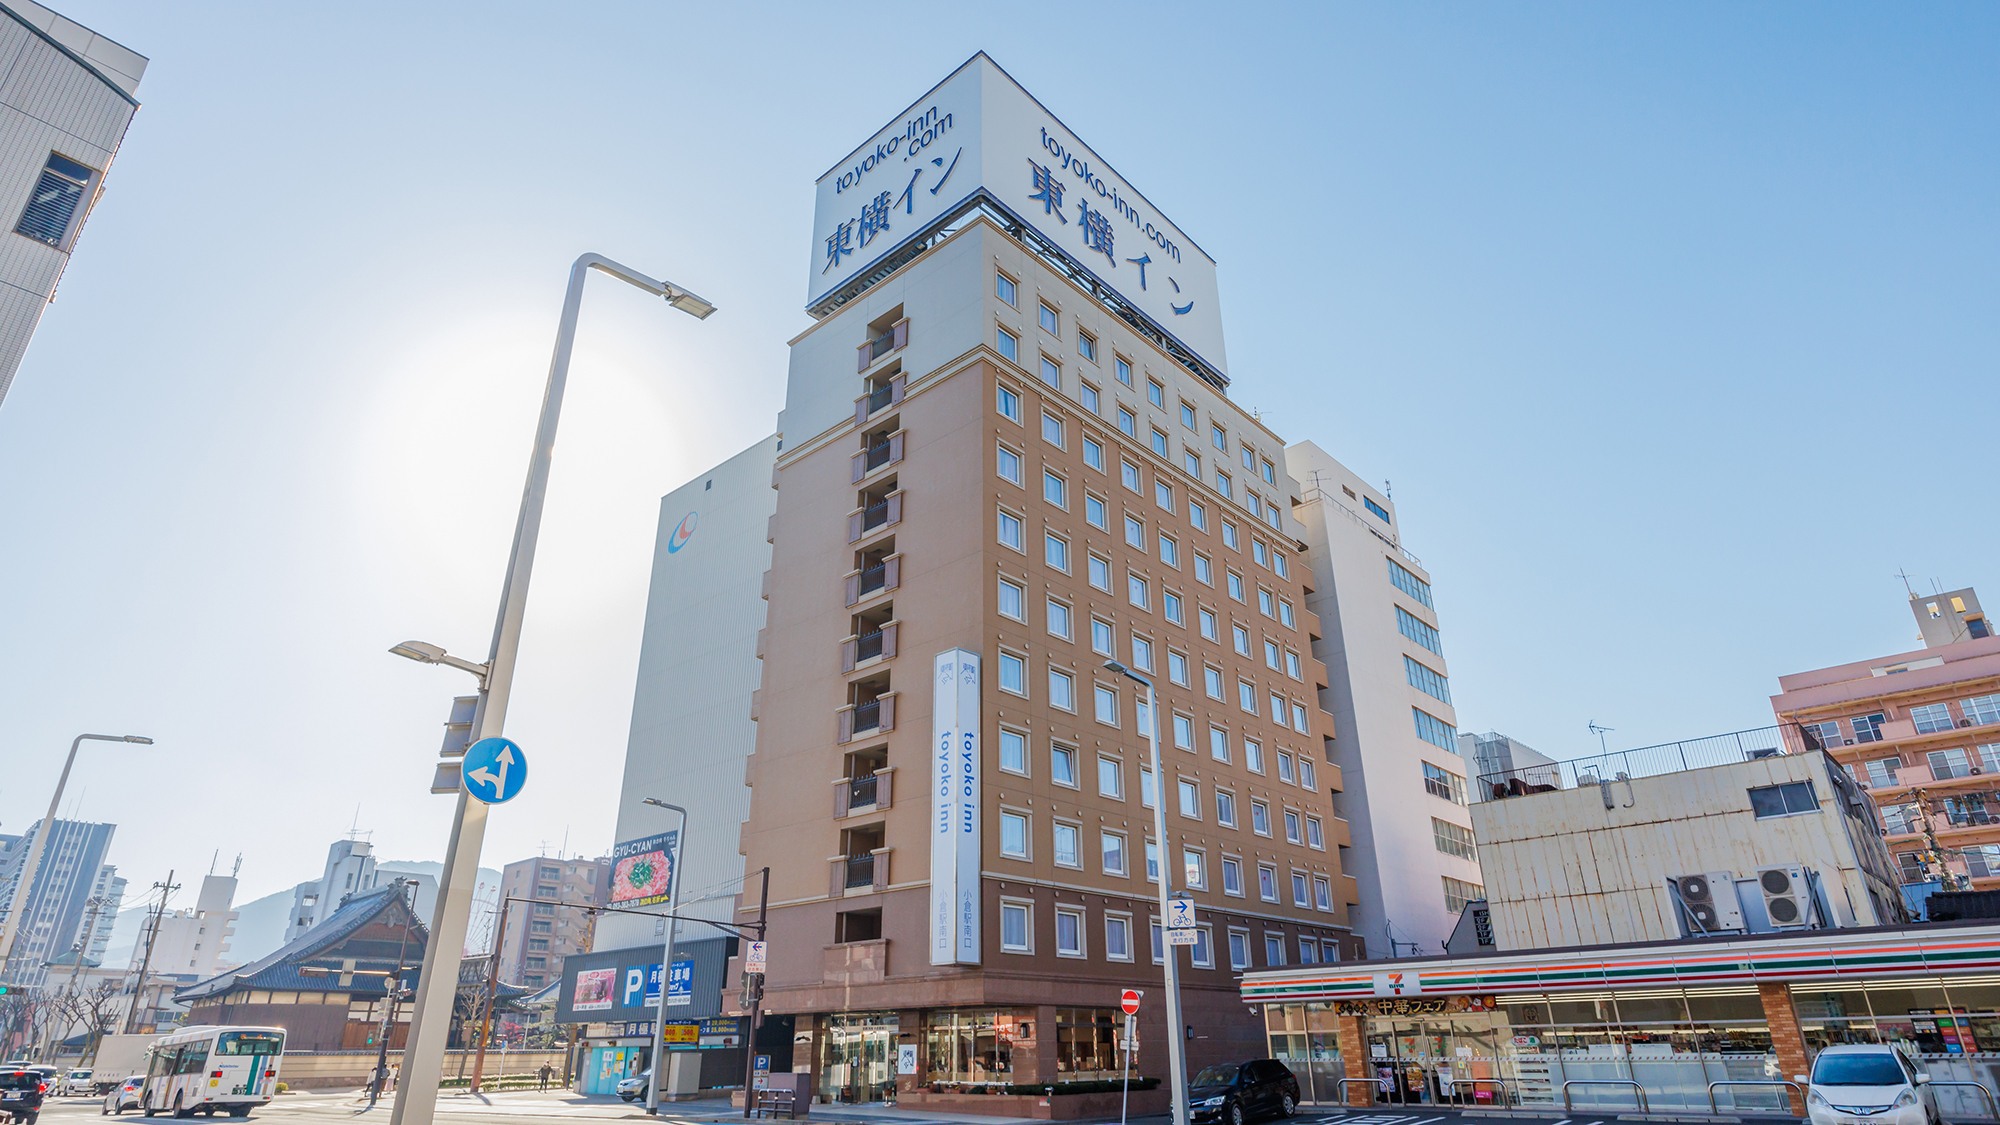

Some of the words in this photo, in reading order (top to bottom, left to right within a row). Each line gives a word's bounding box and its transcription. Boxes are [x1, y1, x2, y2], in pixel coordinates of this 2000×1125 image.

[835, 105, 938, 195] toyoko-inn
[903, 112, 953, 162] .com
[822, 147, 963, 275] 東横イン
[1040, 126, 1182, 264] toyoko-inn.com
[1027, 157, 1194, 316] 東横イン
[939, 731, 951, 797] toyoko
[962, 732, 975, 797] toyoko
[940, 803, 951, 833] inn
[964, 803, 975, 833] inn
[938, 889, 947, 949] 小倉駅南口
[963, 888, 972, 949] 小倉駅南口
[624, 969, 643, 1004] P
[1377, 999, 1446, 1015] 中華フェア
[1388, 973, 1403, 994] 7
[757, 1057, 766, 1068] P
